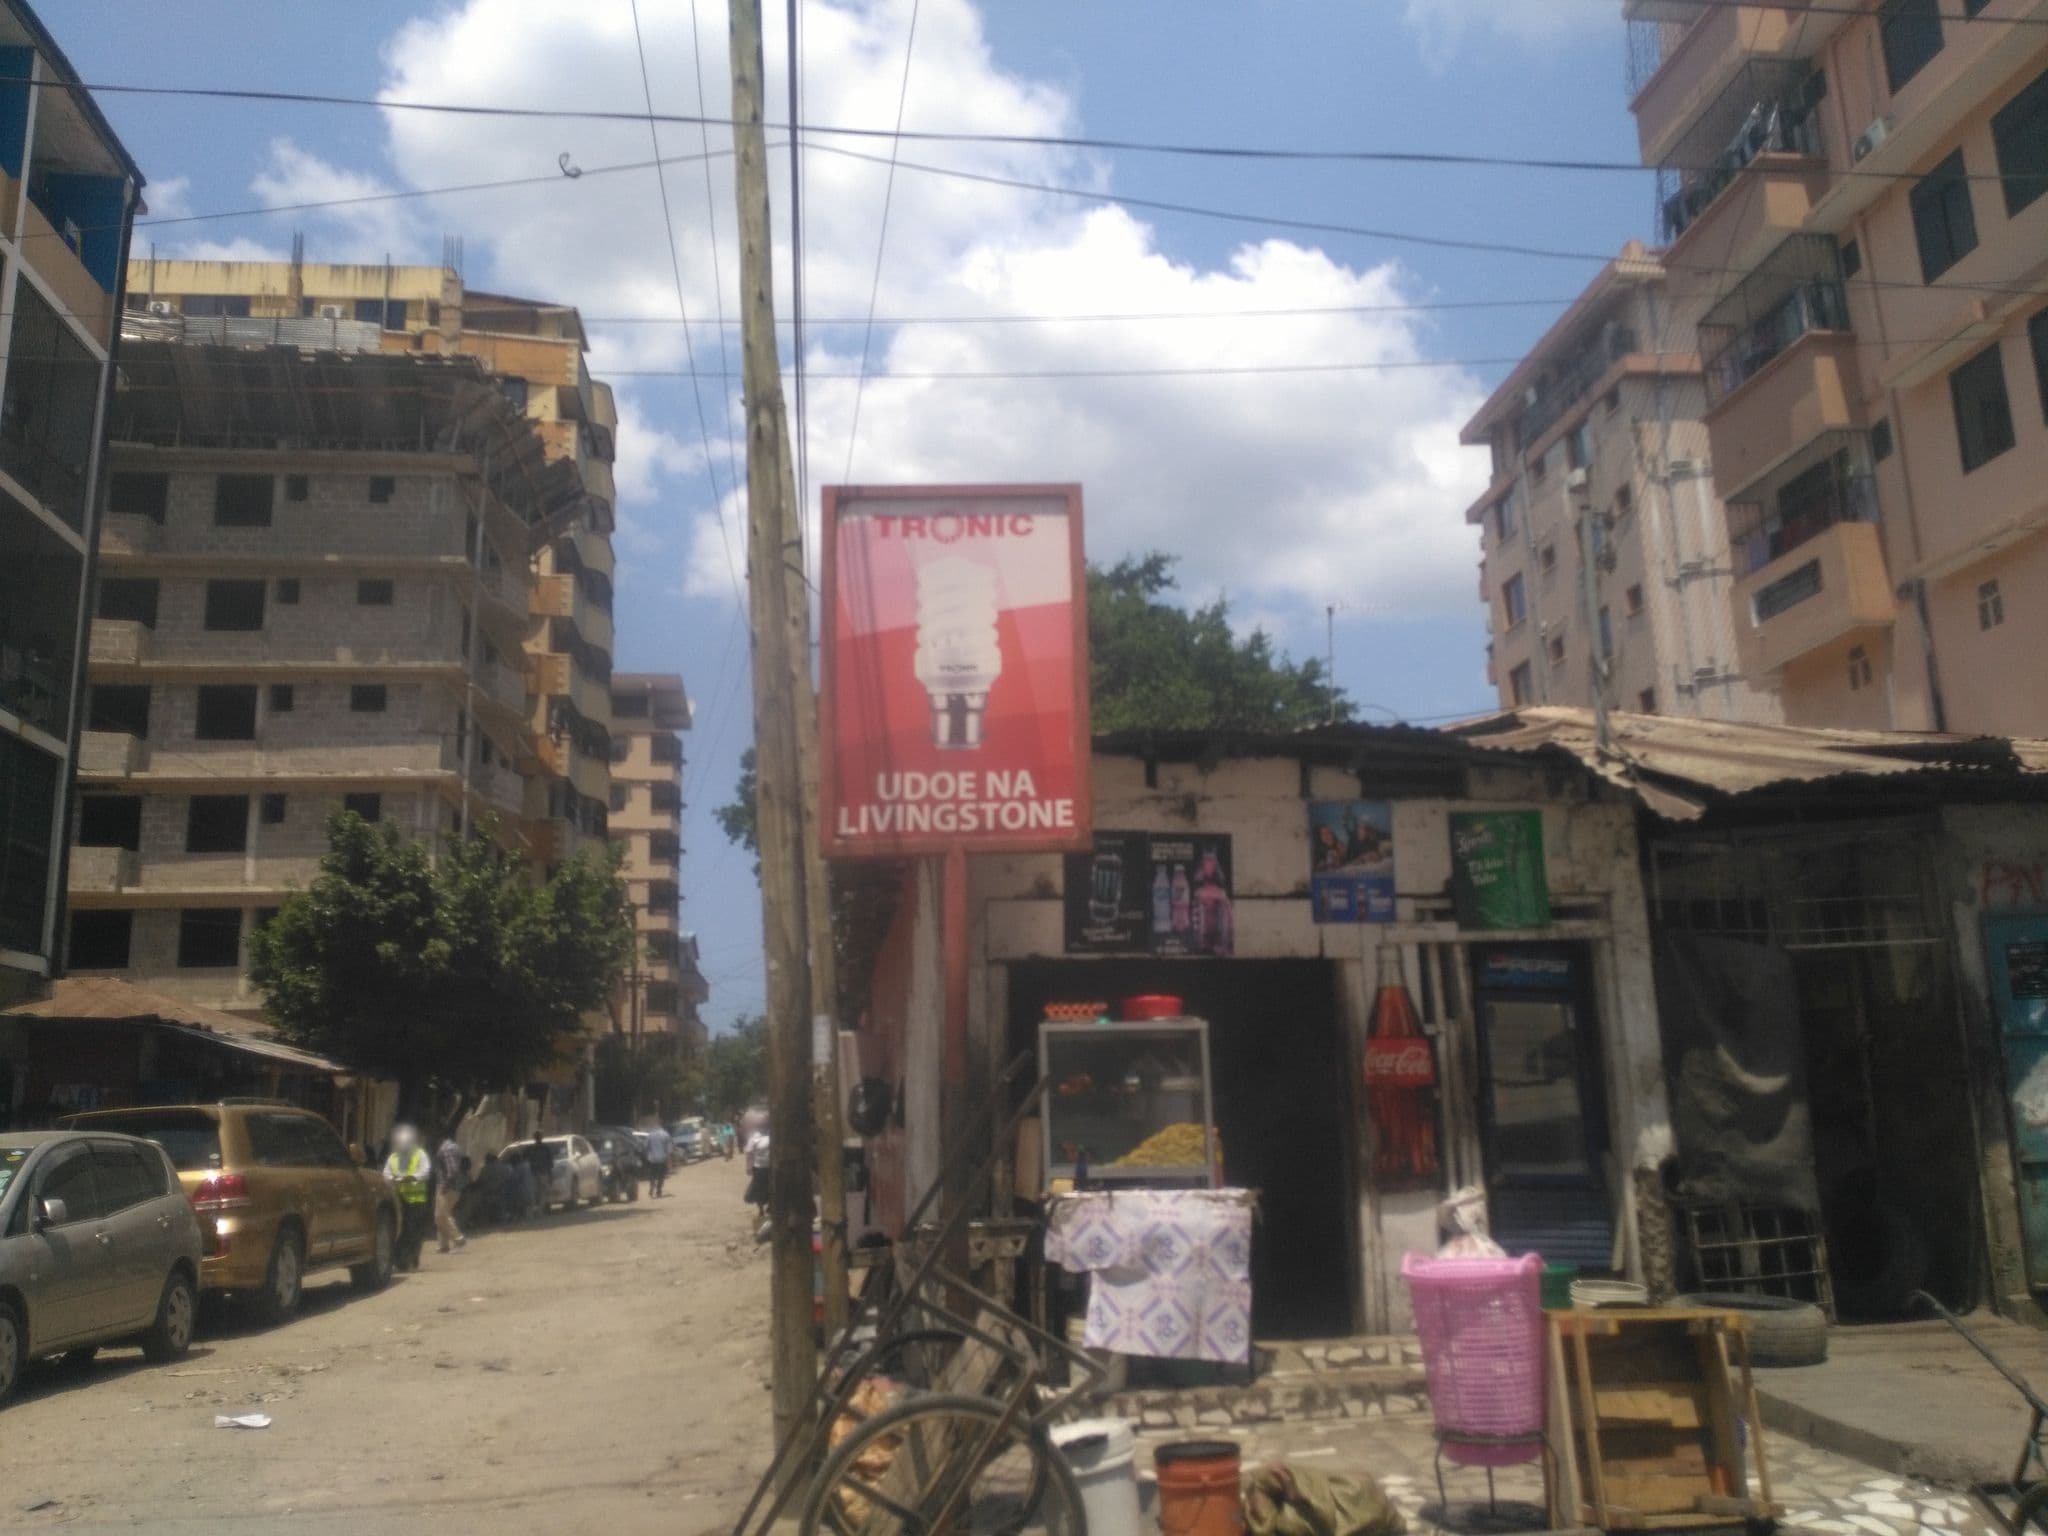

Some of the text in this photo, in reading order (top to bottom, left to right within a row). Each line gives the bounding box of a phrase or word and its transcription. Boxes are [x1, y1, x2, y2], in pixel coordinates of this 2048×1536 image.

[870, 512, 1035, 544] TRONIC
[878, 769, 1036, 801] UDOE NA
[838, 799, 1074, 836] LIVINGSTONE
